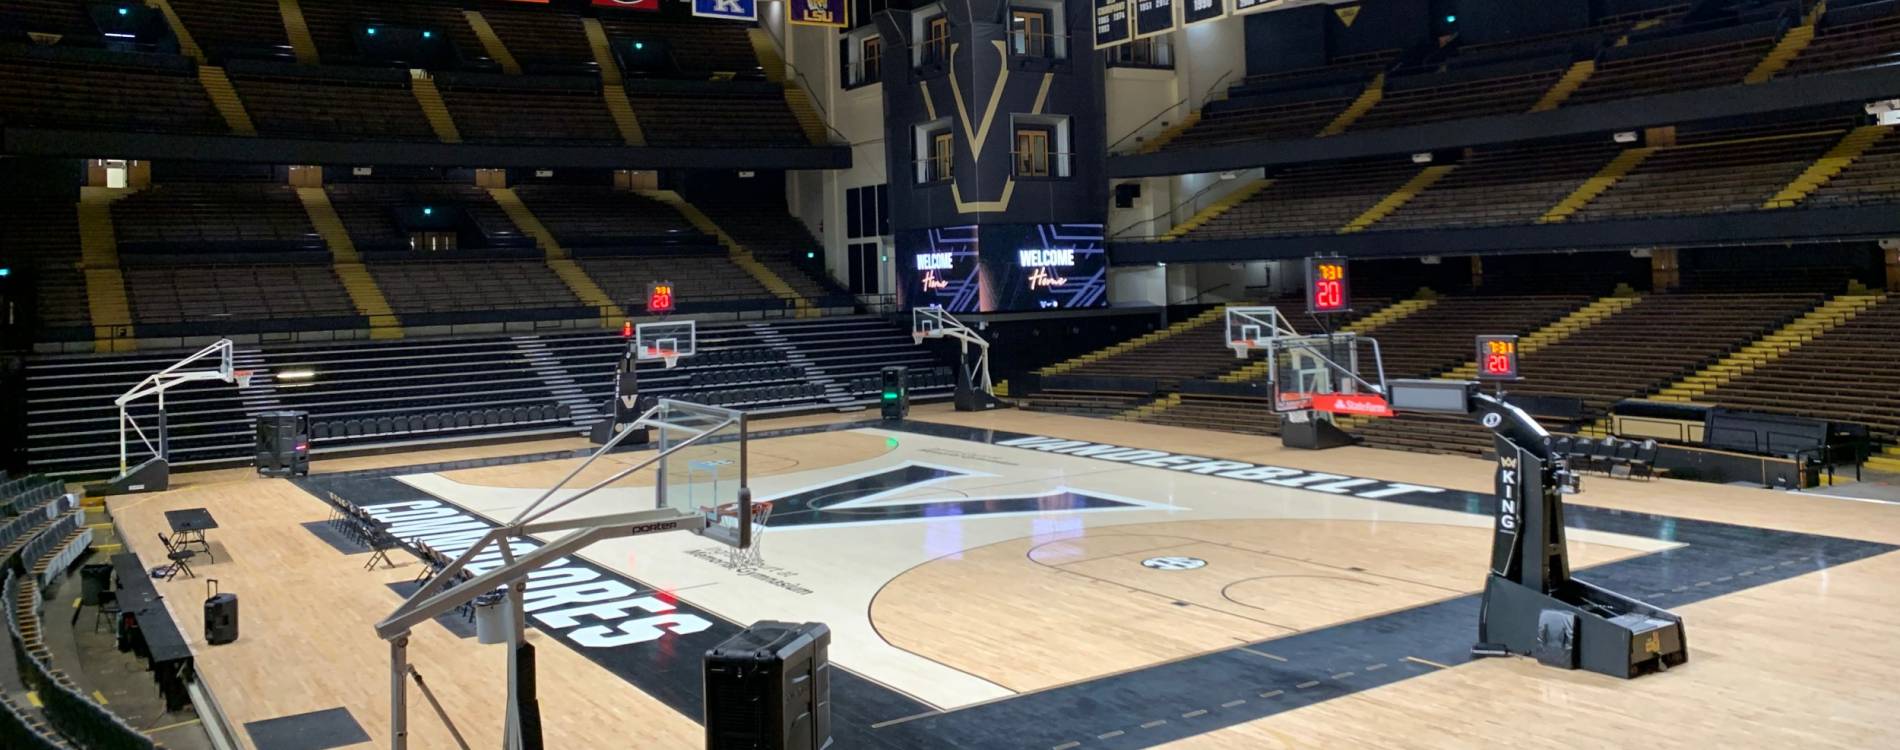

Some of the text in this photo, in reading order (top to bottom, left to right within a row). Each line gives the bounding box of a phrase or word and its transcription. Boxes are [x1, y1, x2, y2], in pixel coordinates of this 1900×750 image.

[804, 9, 833, 22] LSU
[917, 252, 953, 270] WELCOME
[1019, 249, 1075, 267] WELCOME
[922, 271, 949, 292] Home
[1028, 267, 1067, 290] Home
[652, 295, 669, 309] 20
[1318, 281, 1340, 306] 20
[1489, 355, 1508, 372] 20
[995, 436, 1447, 498] VANDERBILT
[1501, 470, 1516, 528] KING
